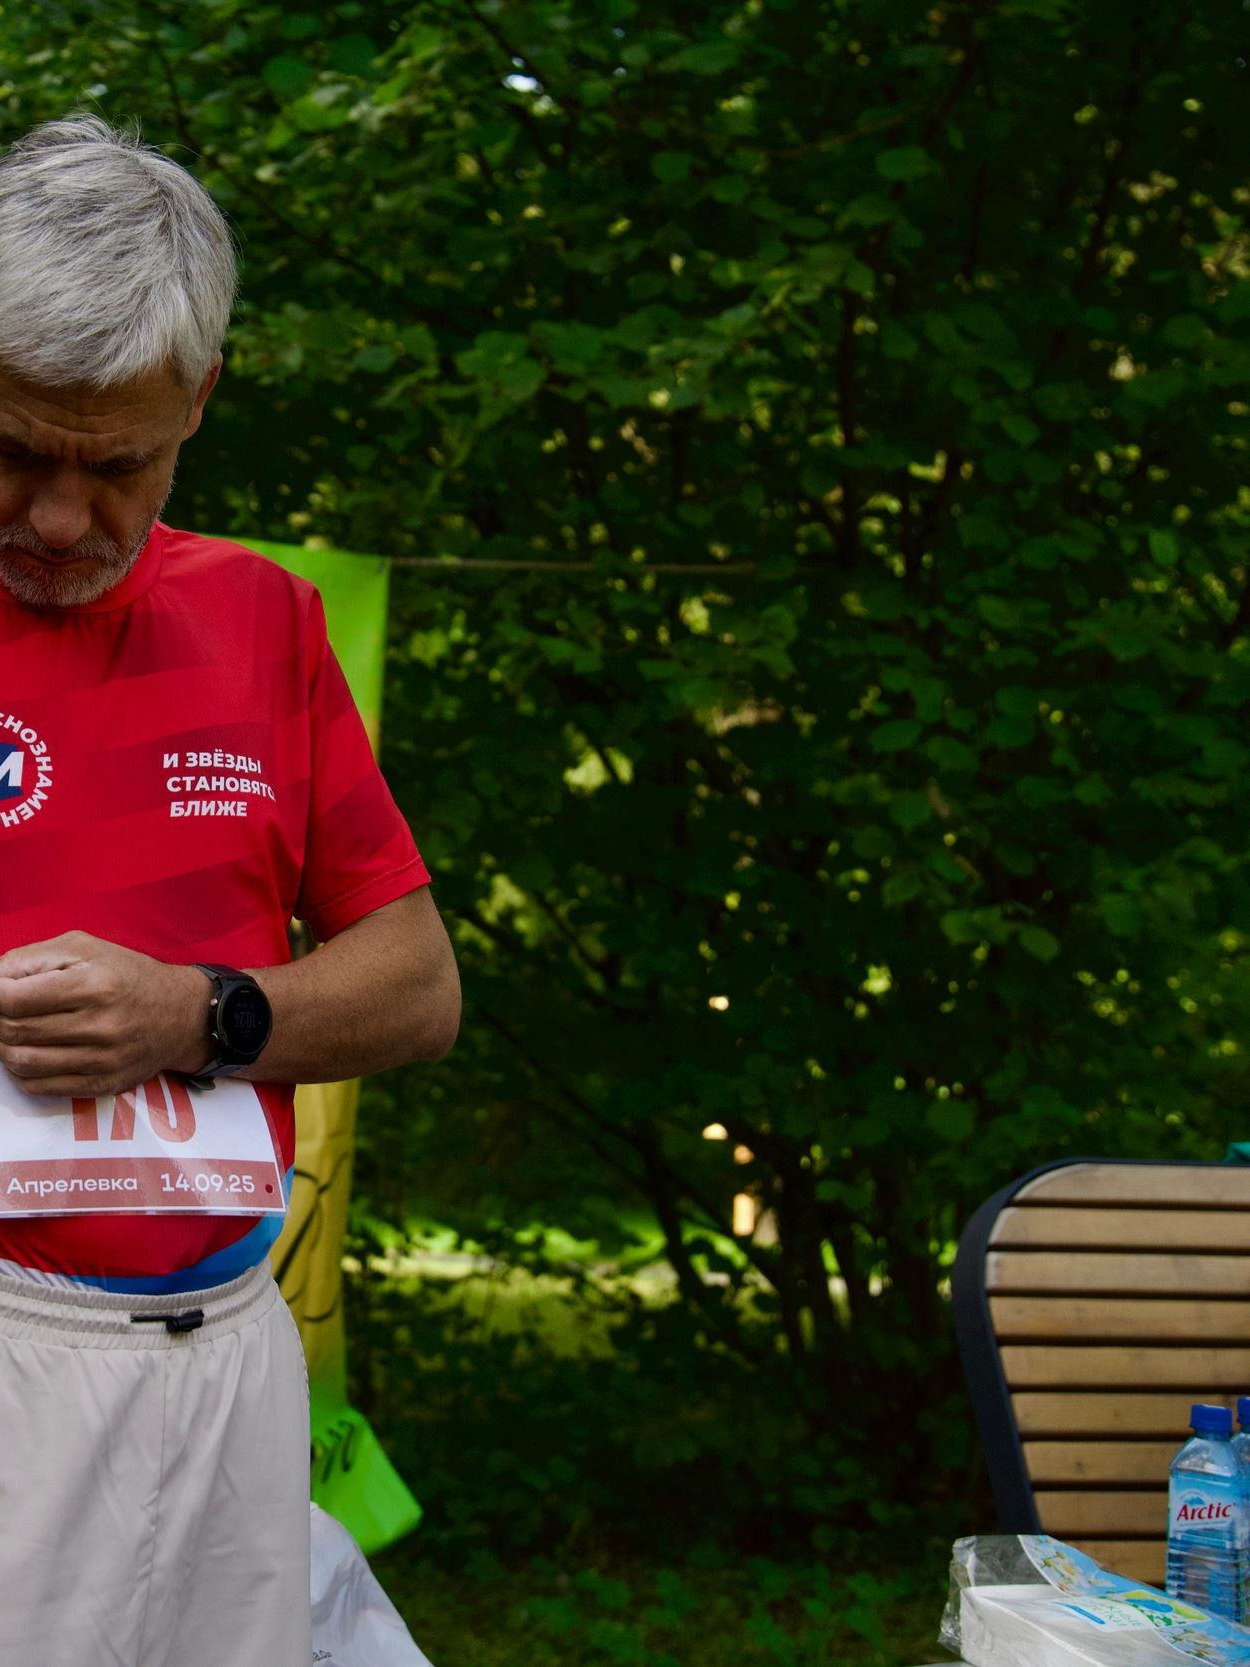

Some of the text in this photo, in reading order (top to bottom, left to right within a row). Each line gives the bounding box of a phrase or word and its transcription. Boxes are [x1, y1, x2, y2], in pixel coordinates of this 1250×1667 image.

[163, 748, 262, 774] И ЗВЁЗДЫ
[166, 775, 276, 802] СТАНОВЯТС
[170, 800, 248, 818] БЛИЖЕ
[6, 1172, 256, 1197] Апрелевка 14.09.25
[1176, 1502, 1232, 1521] Arctic
